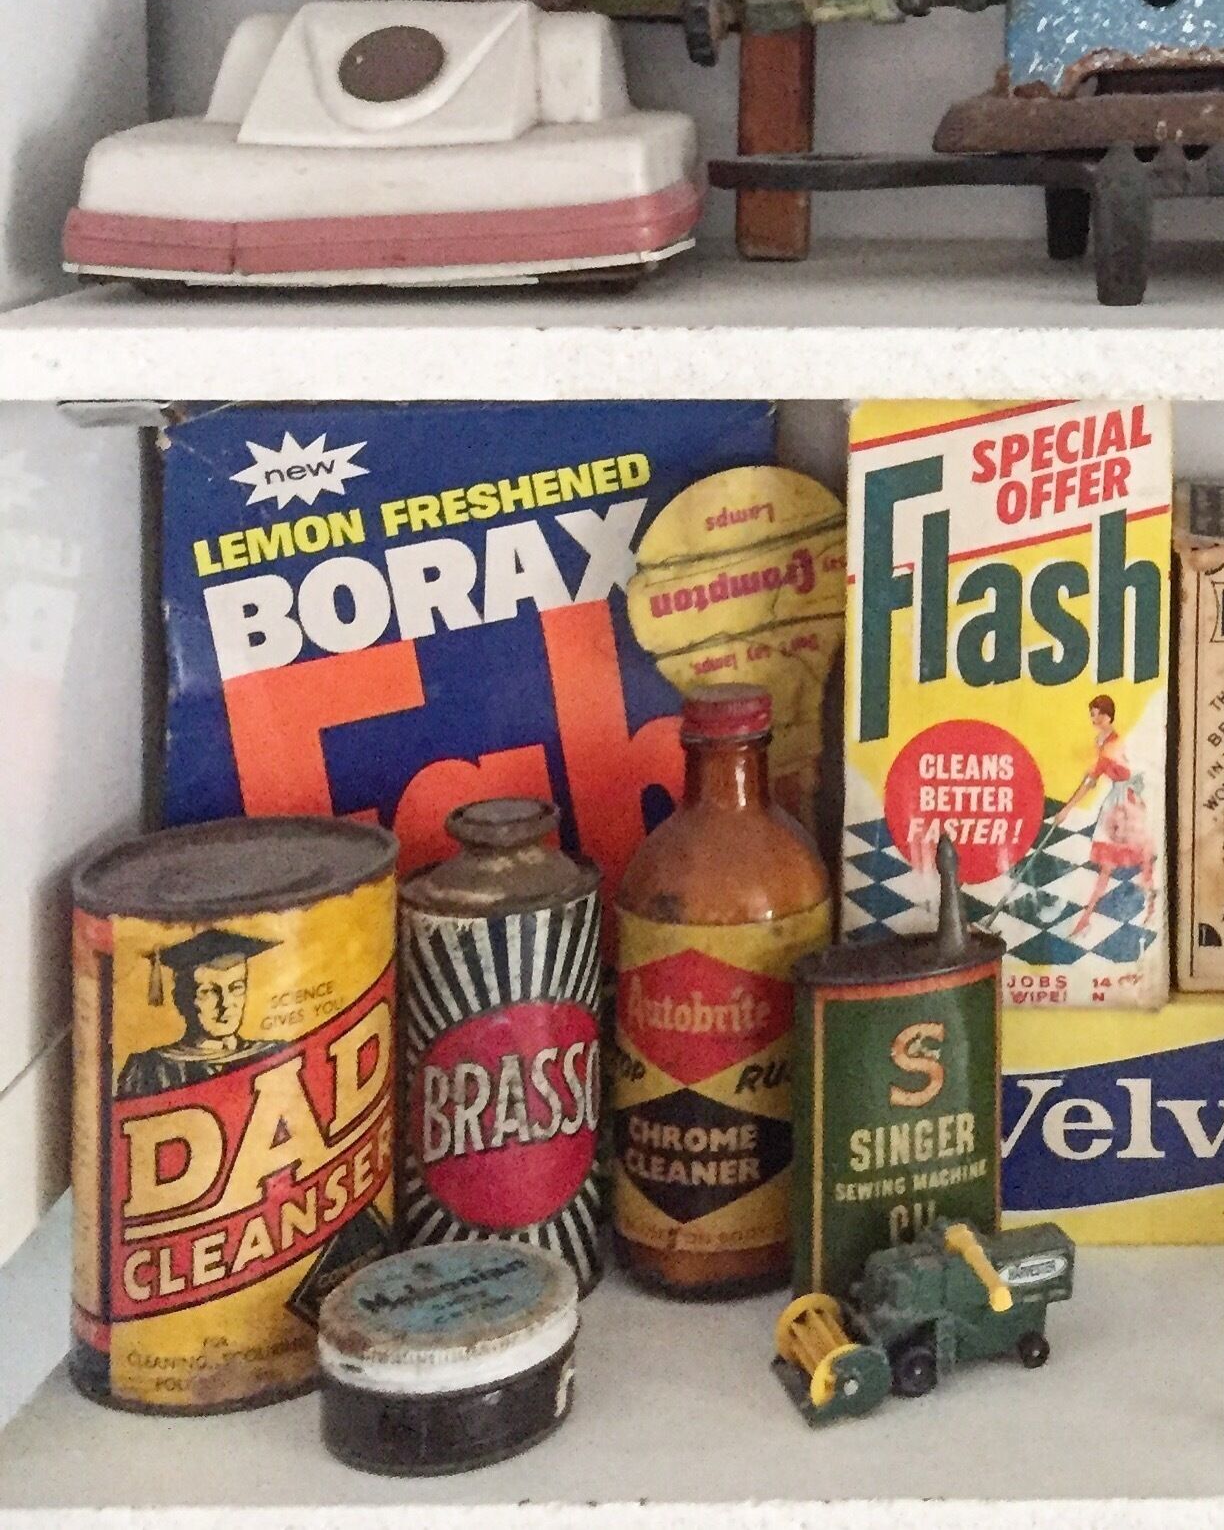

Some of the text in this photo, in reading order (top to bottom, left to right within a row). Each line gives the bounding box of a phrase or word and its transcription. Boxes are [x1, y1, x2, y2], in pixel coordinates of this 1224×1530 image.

[971, 405, 1153, 484] SPECIAL
[263, 455, 338, 485] new
[996, 458, 1131, 525] OFFER
[193, 453, 652, 576] LEMON FRESHENED
[203, 498, 649, 680] BORAX
[859, 455, 1161, 743] Flash
[918, 753, 1015, 781] CLEANS
[1207, 760, 1224, 780] IN
[919, 785, 1014, 812] BETTER
[1007, 975, 1068, 990] JOBS
[889, 1021, 945, 1108] S
[123, 999, 391, 1222] DAD
[628, 1115, 760, 1152] CHROME
[625, 1147, 761, 1186] CLEANER
[849, 1112, 975, 1172] SINGER
[835, 1176, 906, 1202] SEWING
